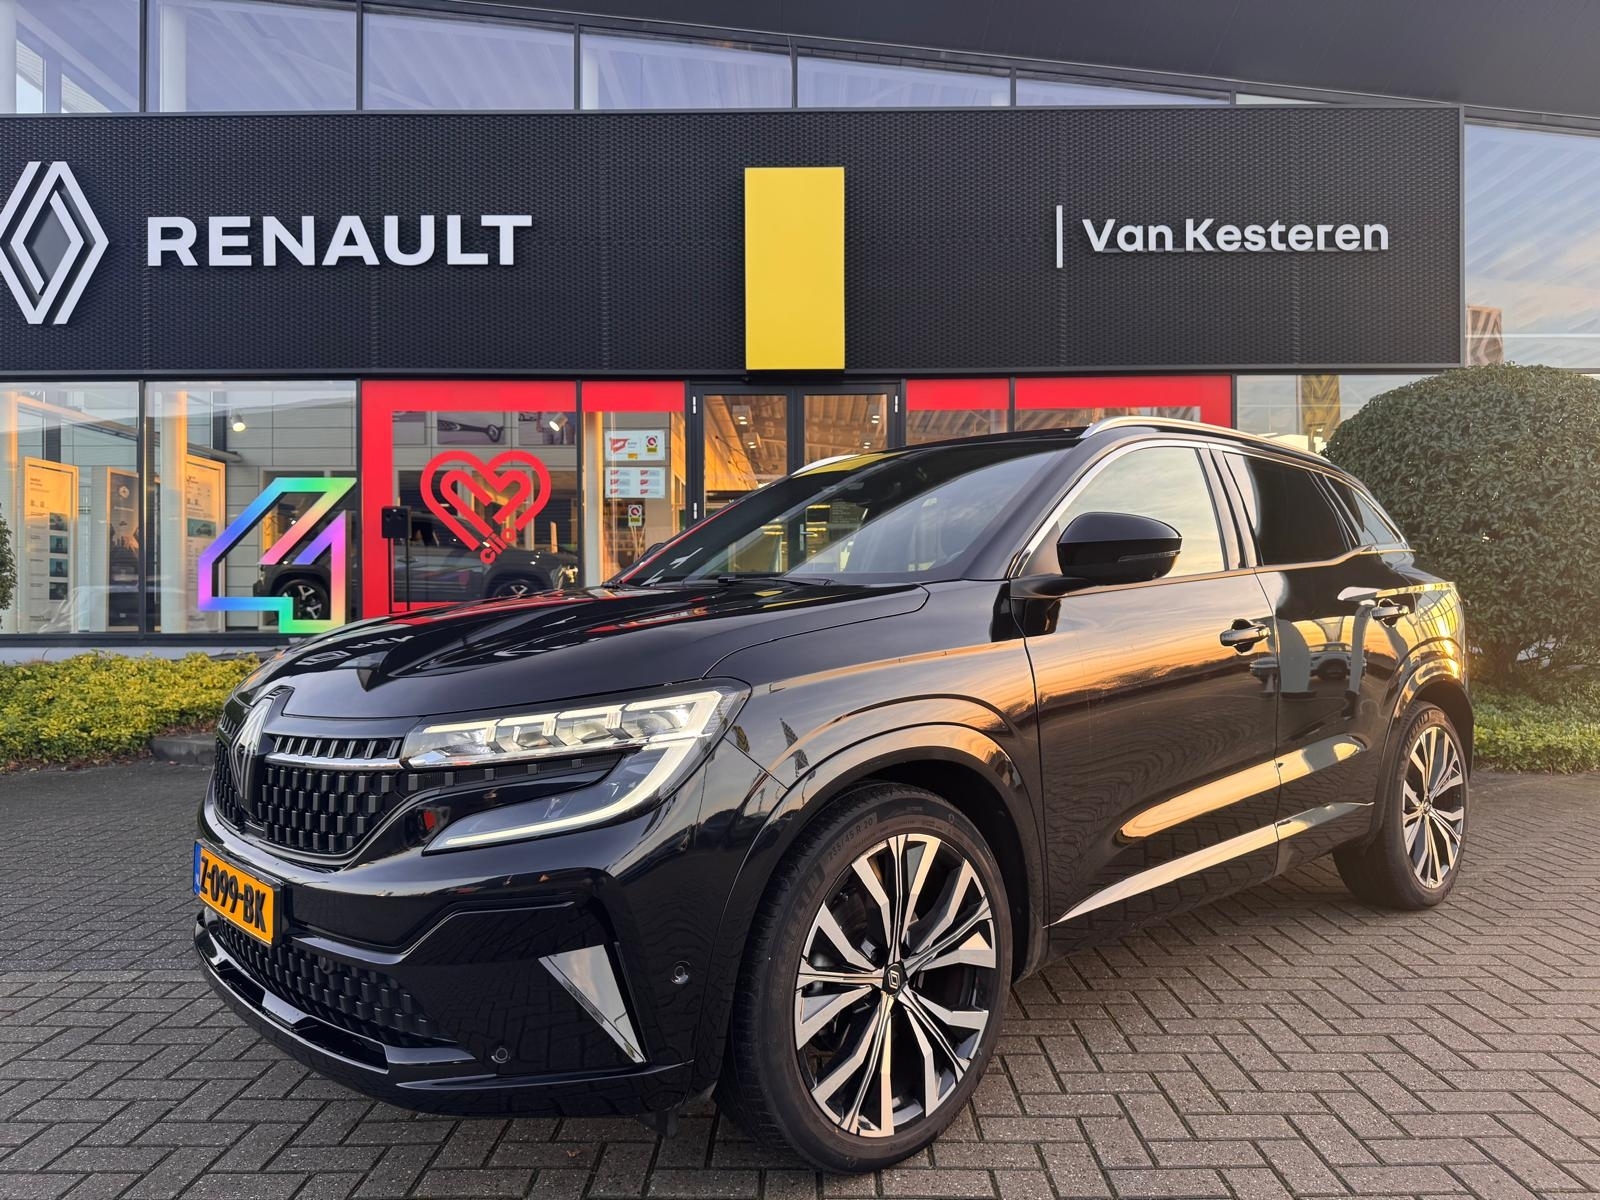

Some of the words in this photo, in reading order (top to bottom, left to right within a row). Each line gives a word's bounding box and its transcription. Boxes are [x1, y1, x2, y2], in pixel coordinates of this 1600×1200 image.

[147, 214, 533, 267] RENAULT
[1082, 218, 1174, 252] Van
[1185, 218, 1389, 252] Kesteren
[200, 856, 266, 933] Z-099-BK
